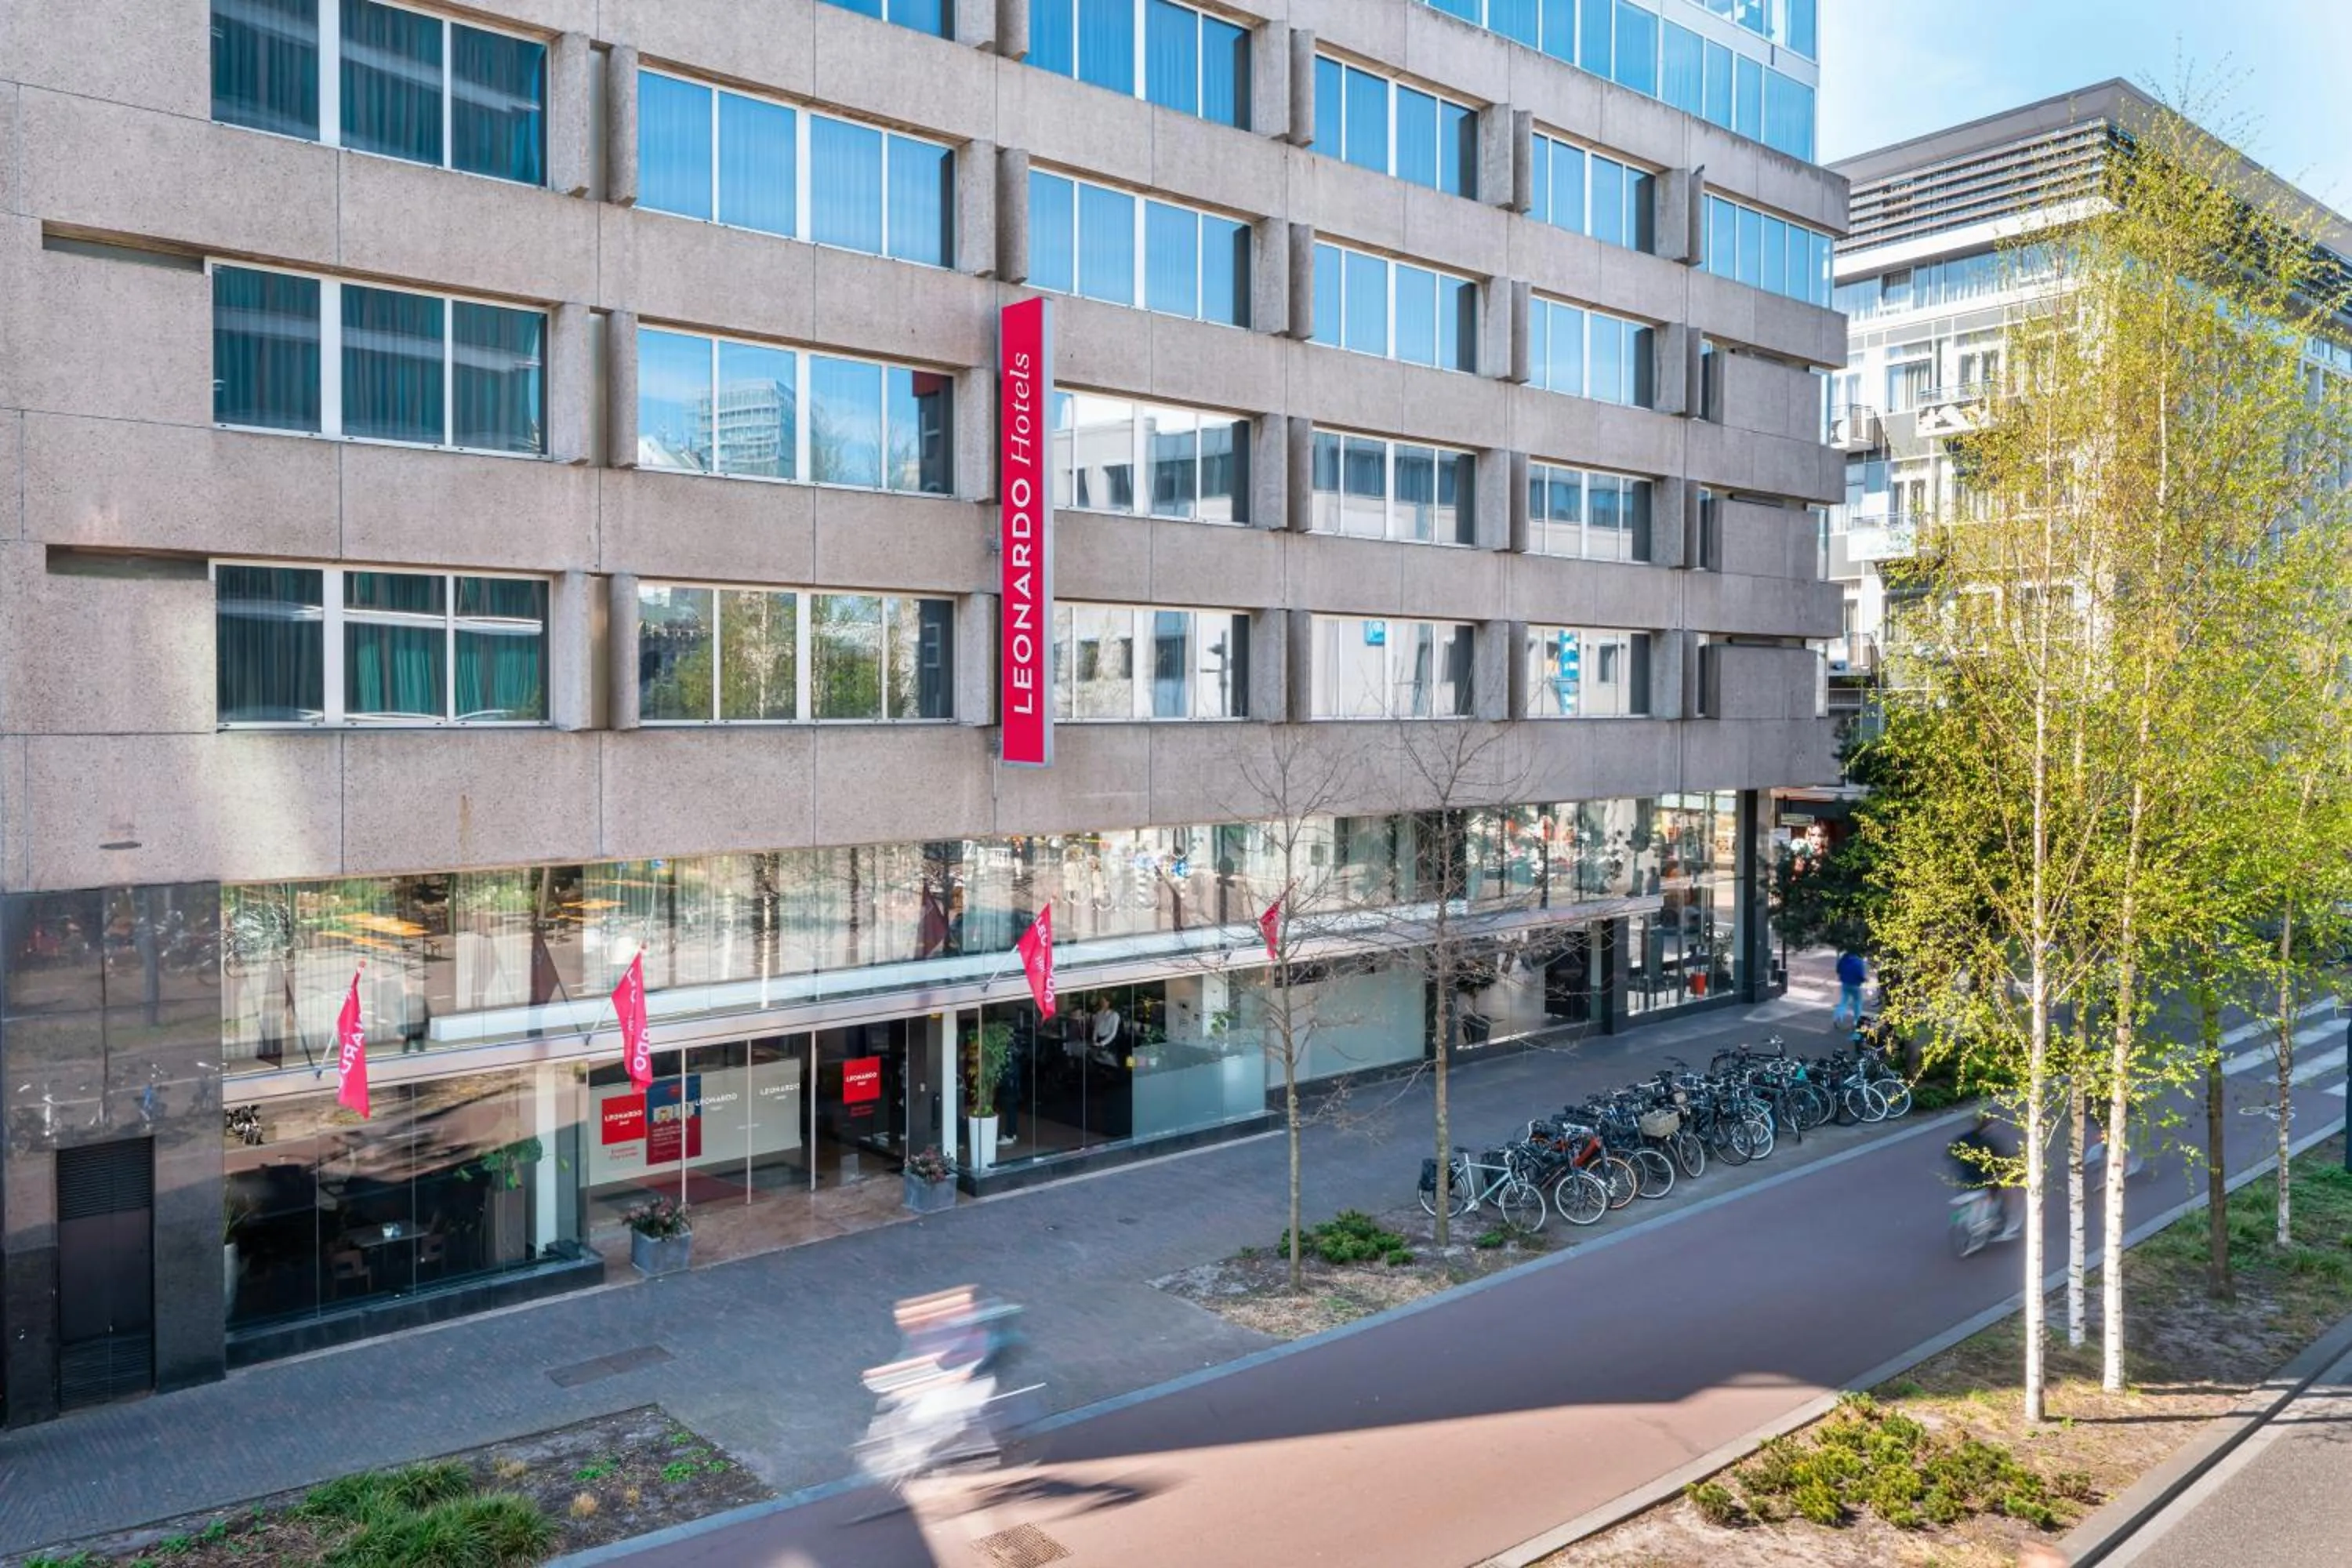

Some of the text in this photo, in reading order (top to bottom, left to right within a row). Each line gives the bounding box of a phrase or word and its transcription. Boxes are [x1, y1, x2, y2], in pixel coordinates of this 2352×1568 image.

[1009, 350, 1033, 716] LEONARDO Hotels
[846, 1072, 878, 1083] LEONARDO
[604, 1109, 644, 1123] LEONARDO
